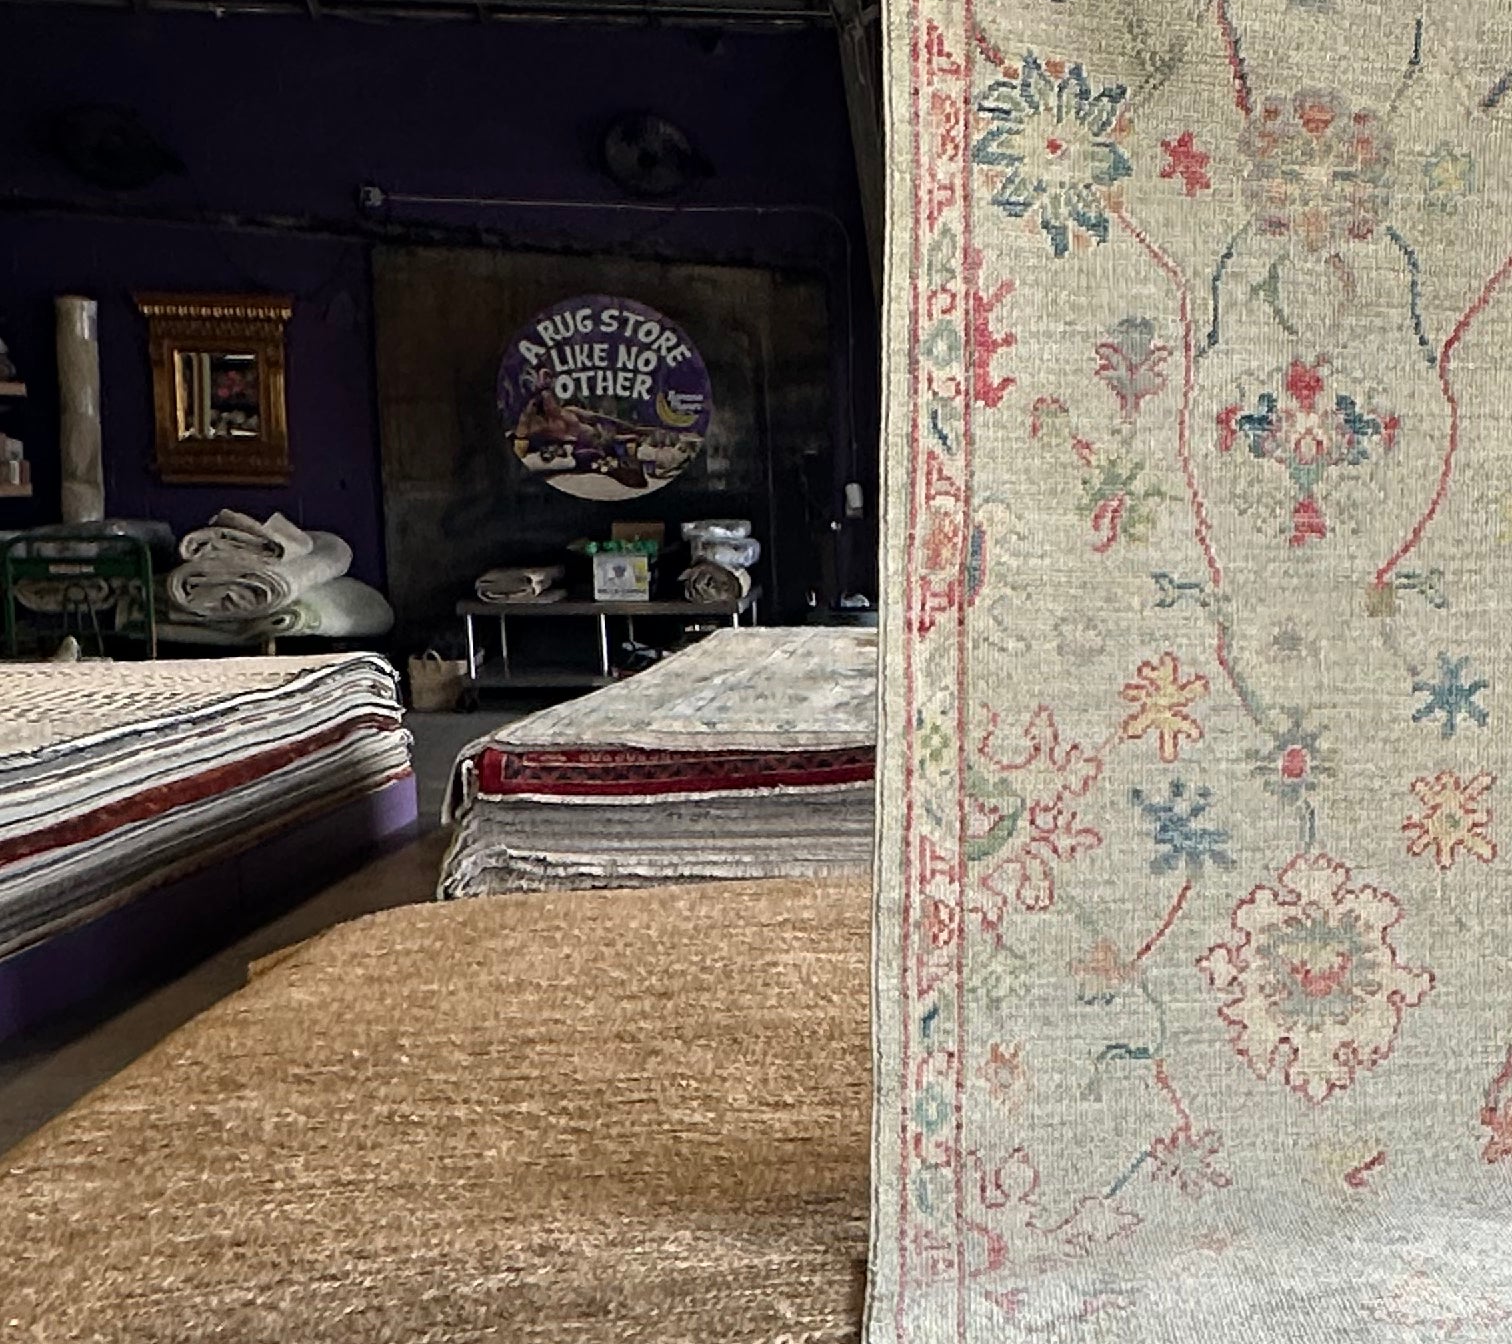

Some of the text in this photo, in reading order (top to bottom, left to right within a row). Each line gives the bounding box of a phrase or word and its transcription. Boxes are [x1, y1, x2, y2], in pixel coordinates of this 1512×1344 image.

[518, 308, 692, 367] A RUG STORE
[550, 343, 658, 372] LIKE NO
[555, 370, 653, 401] OTHER
